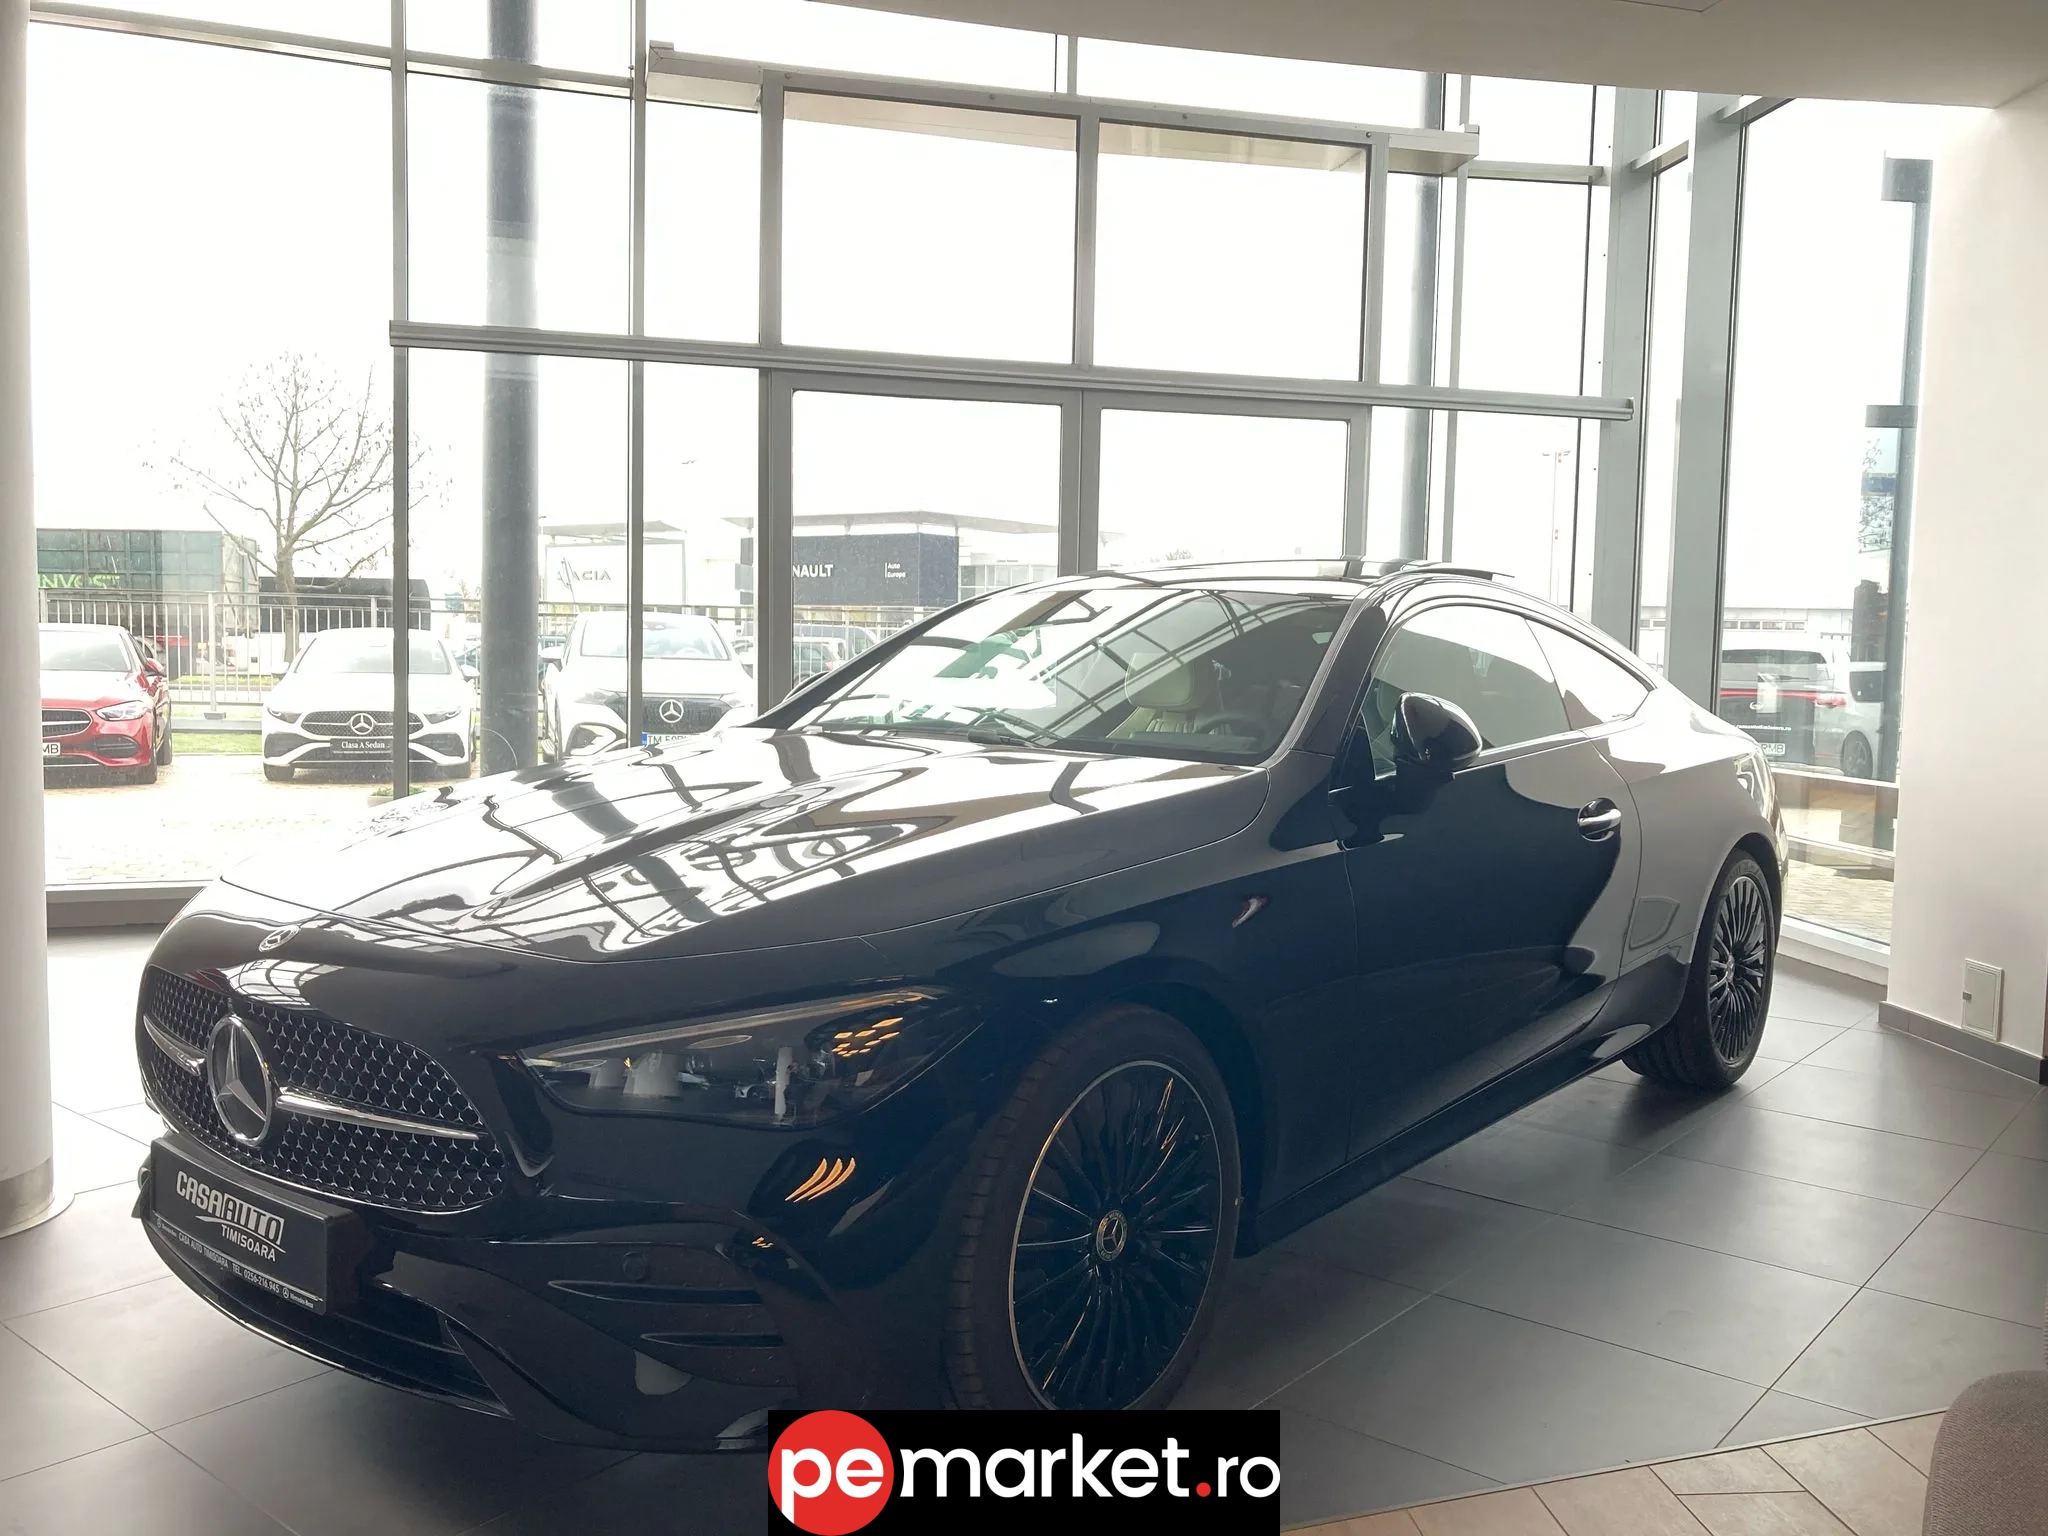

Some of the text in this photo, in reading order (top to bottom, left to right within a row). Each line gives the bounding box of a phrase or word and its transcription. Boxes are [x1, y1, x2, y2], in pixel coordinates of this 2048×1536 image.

[792, 564, 833, 577] NAULT
[365, 741, 385, 749] Sedan
[221, 1224, 276, 1262] TIMISOARA
